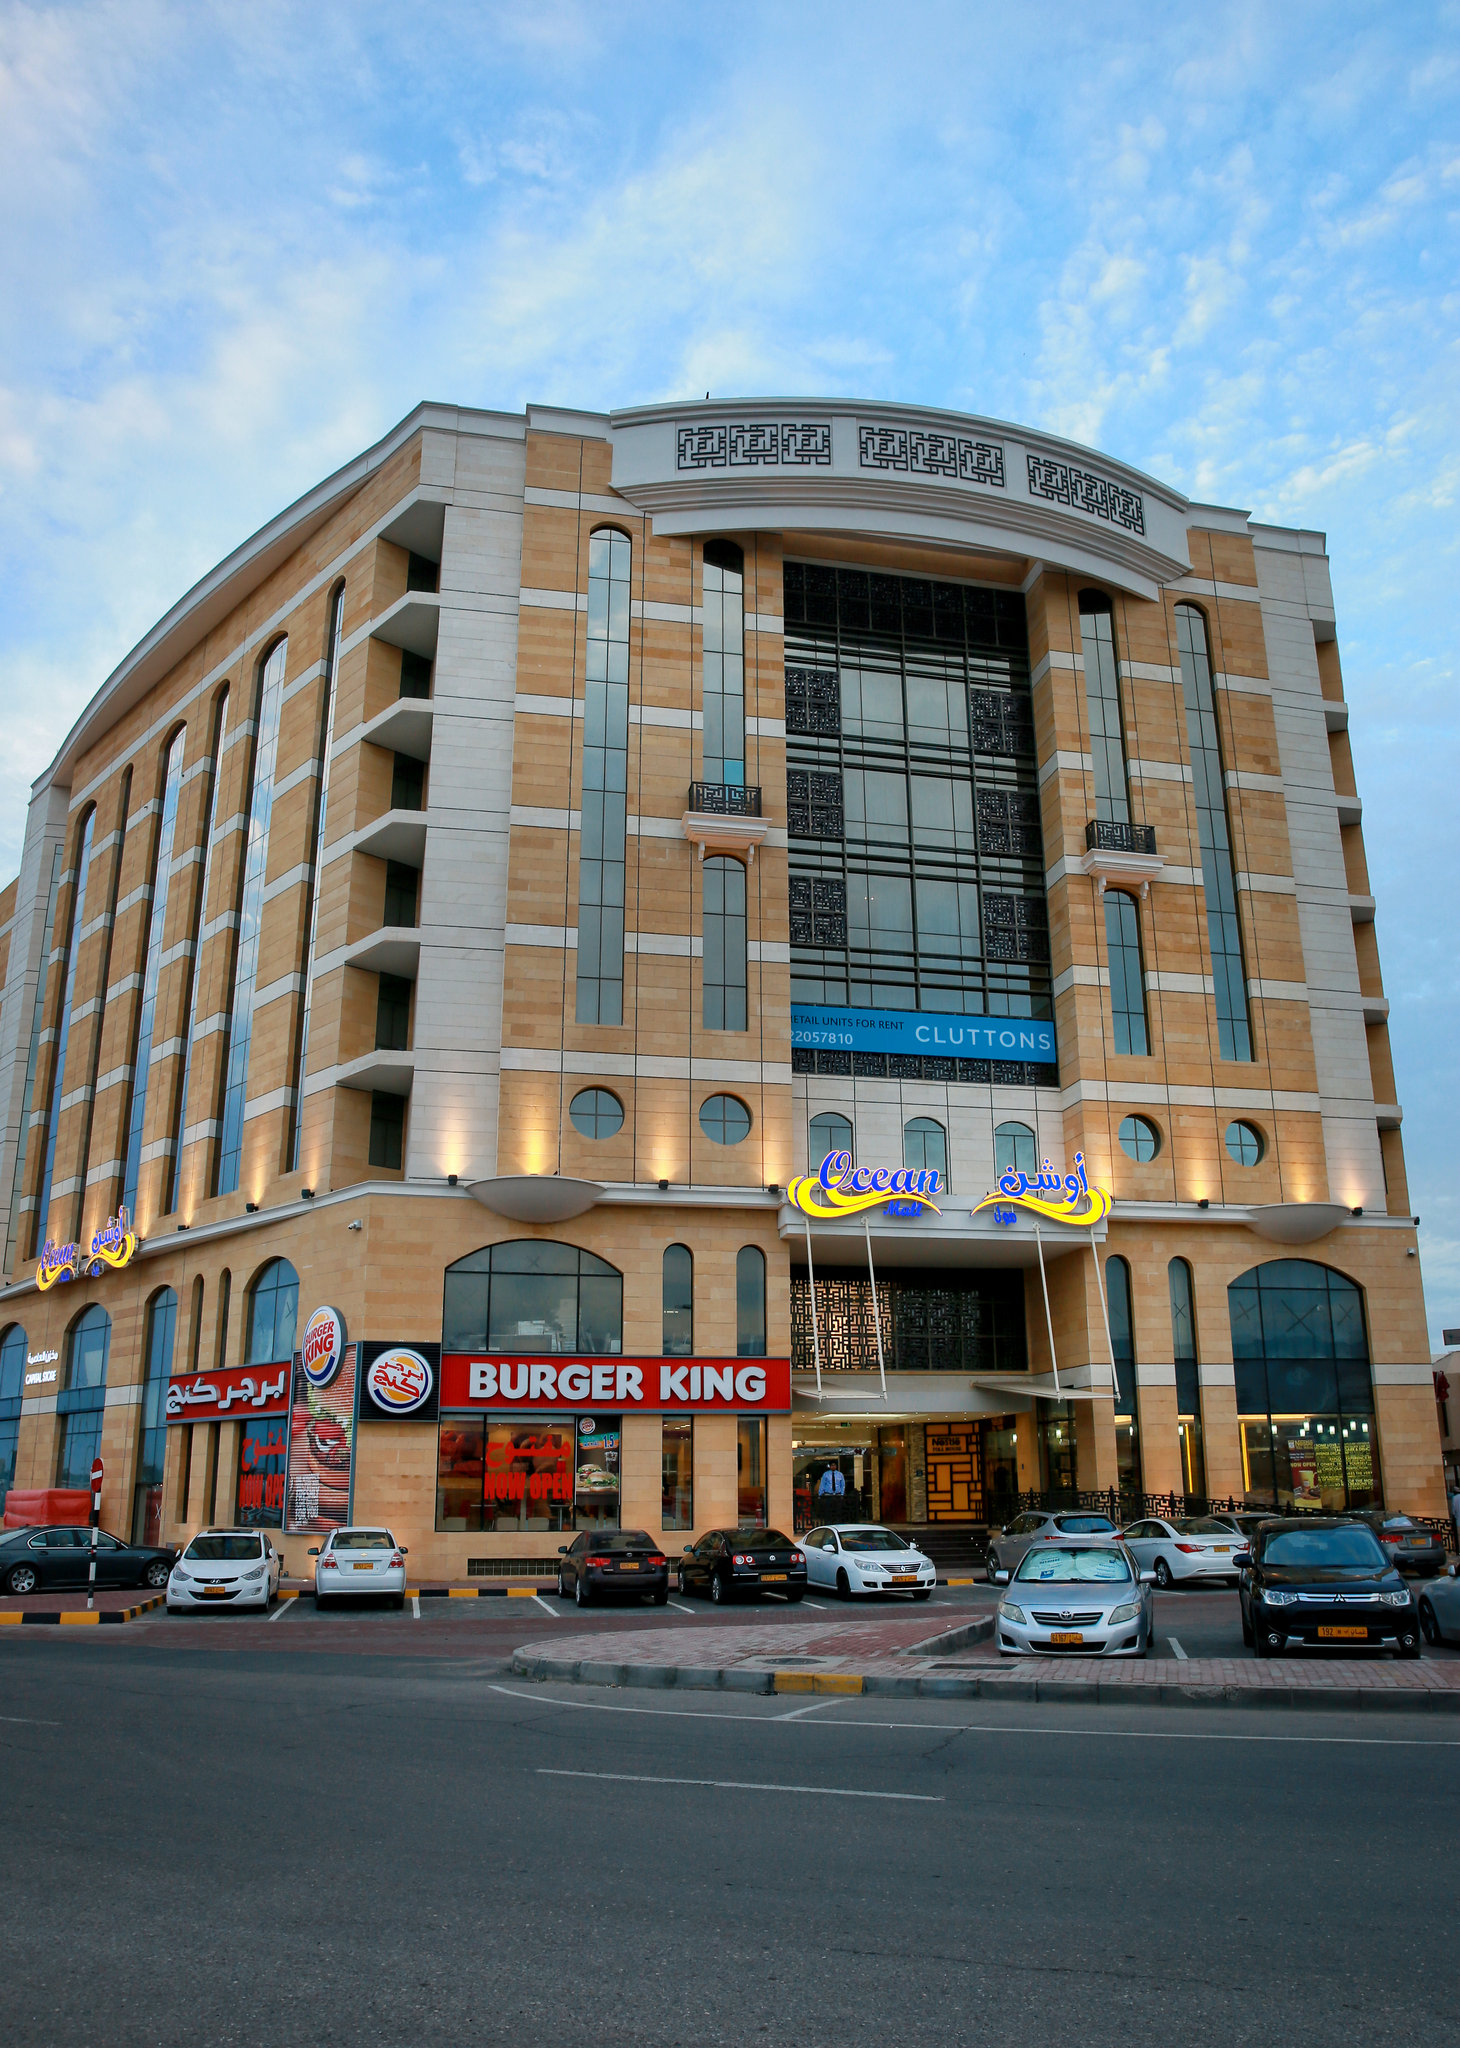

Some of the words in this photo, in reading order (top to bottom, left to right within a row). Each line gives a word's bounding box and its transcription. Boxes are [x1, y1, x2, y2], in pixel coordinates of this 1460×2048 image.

[822, 1017, 854, 1028] UNITS
[856, 1019, 876, 1029] FOR
[879, 1020, 905, 1031] RENT
[915, 1025, 1051, 1050] CLUTTONS
[819, 1150, 944, 1195] Ocean
[999, 1150, 1089, 1204] أوشن
[883, 1200, 923, 1217] Mall
[305, 1320, 335, 1347] BURGER
[304, 1333, 334, 1368] KING
[373, 1369, 420, 1399] كنج
[378, 1362, 424, 1381] برجر
[469, 1362, 644, 1400] BURGER
[660, 1365, 767, 1401] KING
[166, 1377, 219, 1414] كنج
[218, 1370, 287, 1409] برجر
[486, 1434, 571, 1469] مفتوح
[239, 1474, 264, 1509] NOW
[265, 1473, 285, 1509] OPE
[484, 1472, 526, 1500] NOW
[529, 1472, 573, 1500] OPEN
[1322, 1627, 1334, 1636] 192
